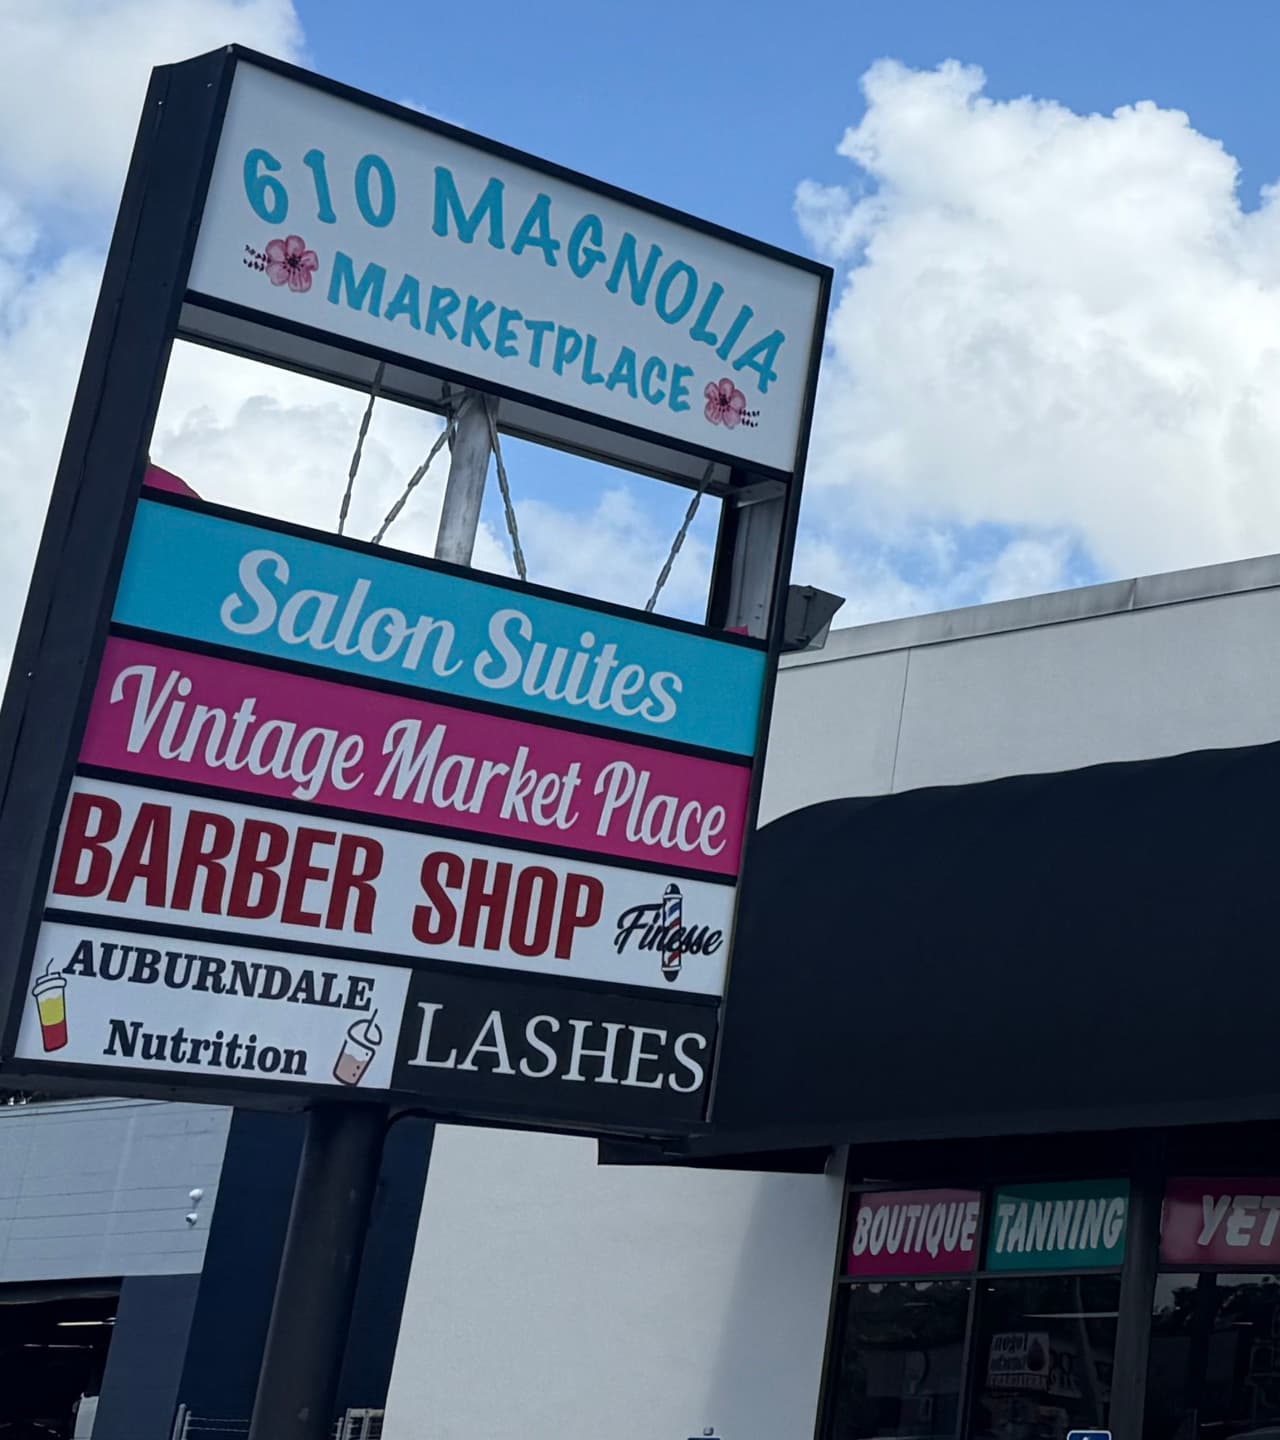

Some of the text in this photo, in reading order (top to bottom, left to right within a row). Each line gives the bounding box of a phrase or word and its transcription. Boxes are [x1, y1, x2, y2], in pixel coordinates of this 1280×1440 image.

[243, 148, 787, 393] 610 MAGNOLIA
[327, 250, 695, 413] MARKETPLACE
[220, 549, 684, 723] Salon Suites
[110, 664, 727, 857] Vintage Market Place
[52, 792, 604, 960] BARBER SHOP
[62, 940, 376, 1012] AUBURNDALE
[614, 903, 724, 956] Finesse
[103, 1018, 309, 1077] Nutrition
[408, 1002, 708, 1095] LASHES
[851, 1200, 978, 1260] BOUTIQUE
[994, 1196, 1126, 1254] TANNING
